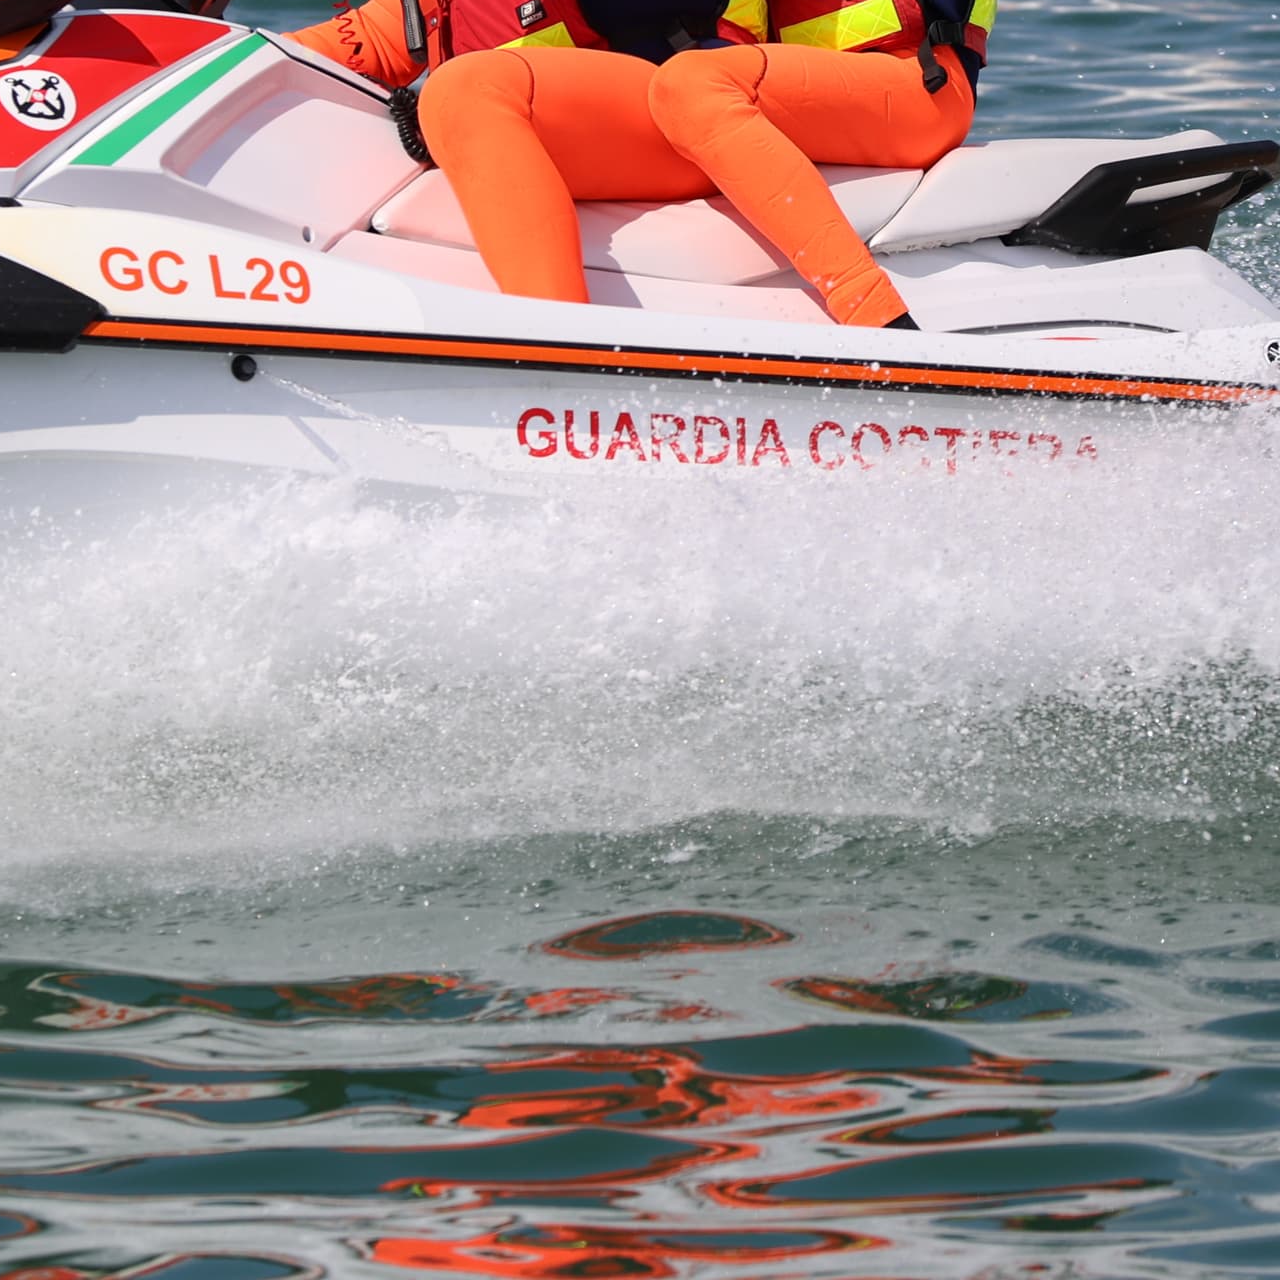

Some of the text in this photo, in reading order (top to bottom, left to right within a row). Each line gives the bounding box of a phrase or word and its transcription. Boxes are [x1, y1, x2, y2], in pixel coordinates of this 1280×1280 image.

[98, 246, 312, 305] GC L29
[515, 406, 791, 467] GUARDIA
